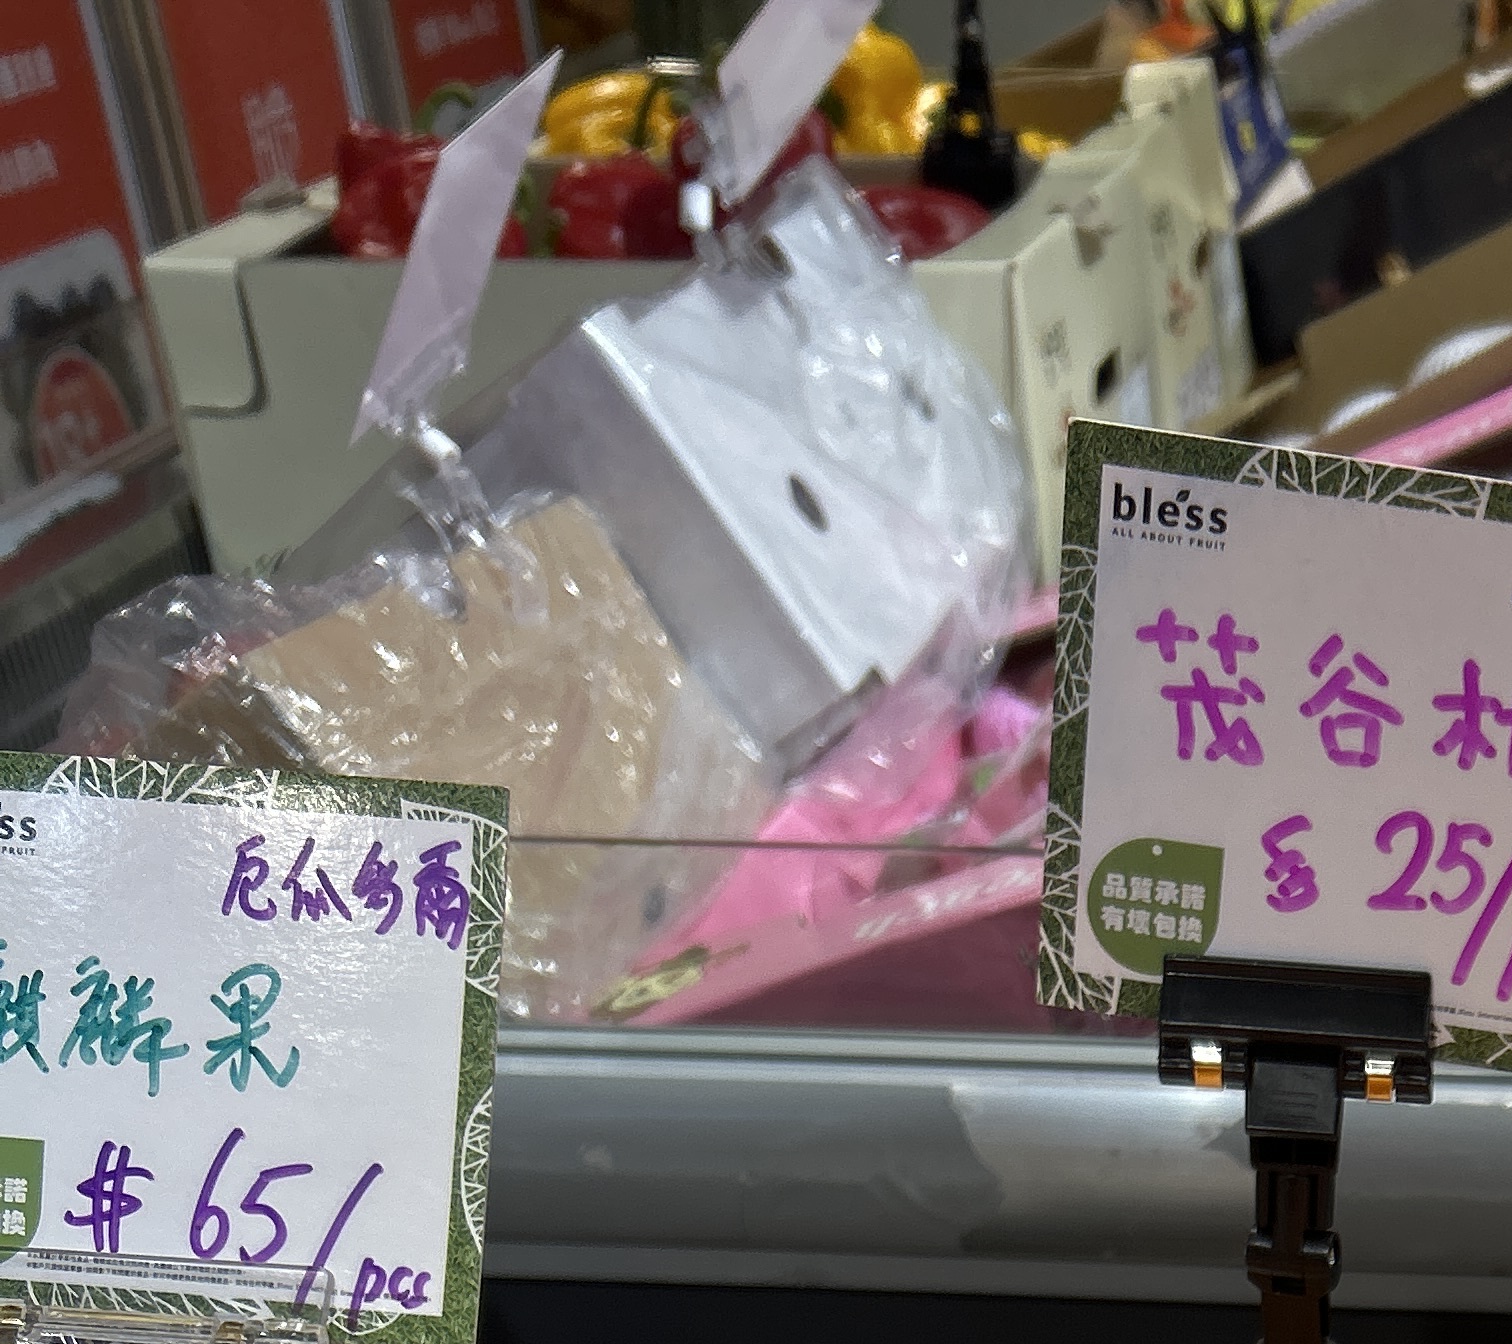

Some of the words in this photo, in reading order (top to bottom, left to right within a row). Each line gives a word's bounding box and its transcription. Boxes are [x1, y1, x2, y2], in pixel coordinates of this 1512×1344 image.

[1111, 527, 1134, 539] ALL
[1141, 531, 1183, 546] ABOUT
[1189, 537, 1226, 552] FRUIT
[1102, 873, 1206, 911] 品質承諾
[65, 1140, 155, 1254] $
